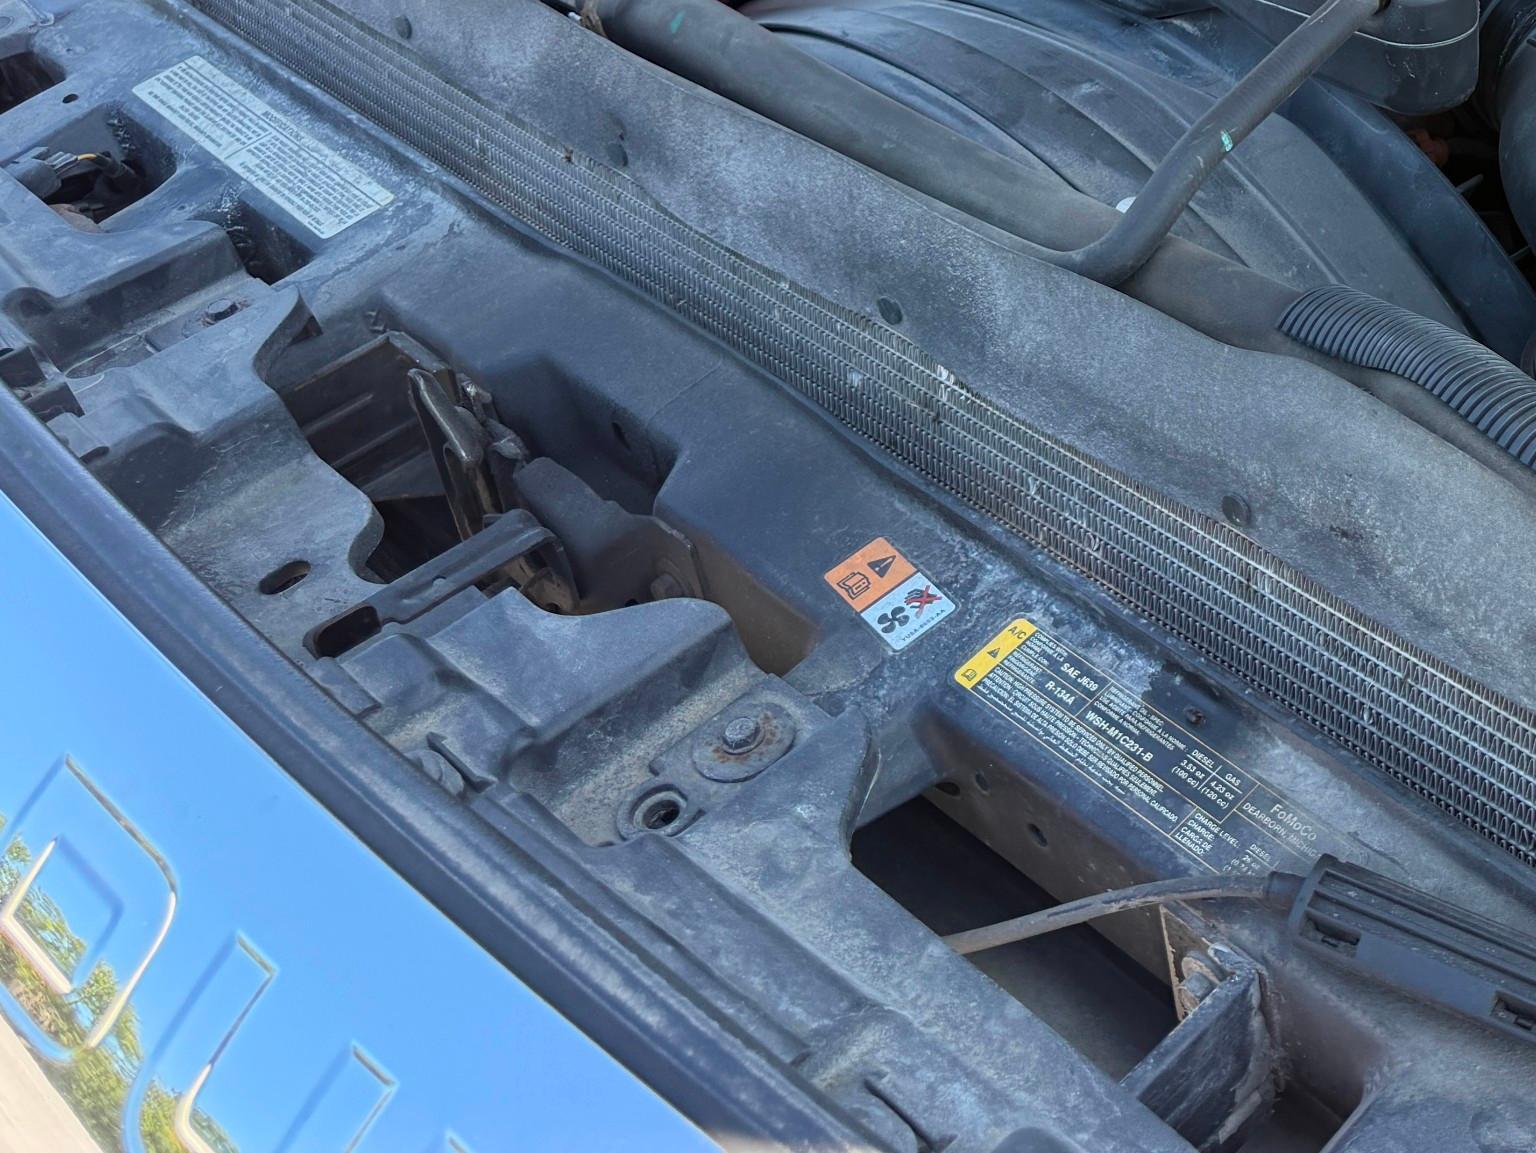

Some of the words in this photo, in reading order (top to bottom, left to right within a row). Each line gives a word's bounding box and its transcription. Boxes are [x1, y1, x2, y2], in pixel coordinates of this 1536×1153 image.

[1008, 625, 1027, 639] A/C
[1044, 681, 1077, 704] R-134A
[1060, 663, 1080, 677] SAE
[1076, 675, 1099, 691] J639
[1082, 711, 1155, 761] WSH-M1C231-B
[1179, 759, 1197, 772] 3.53
[1209, 780, 1226, 792] 4.23
[1223, 791, 1235, 799] oz
[1191, 749, 1216, 767] DIESEL
[1224, 773, 1241, 785] GAS
[1170, 766, 1188, 779] (100
[1185, 776, 1200, 787] cc)
[1200, 787, 1218, 800] (120
[1213, 797, 1229, 809] cc)
[1180, 826, 1204, 843] CARGA
[1201, 842, 1213, 850] DE
[1193, 813, 1221, 832] CHARGE
[1243, 802, 1287, 839] DEARBORN,
[1270, 804, 1317, 840] FoMoCo
